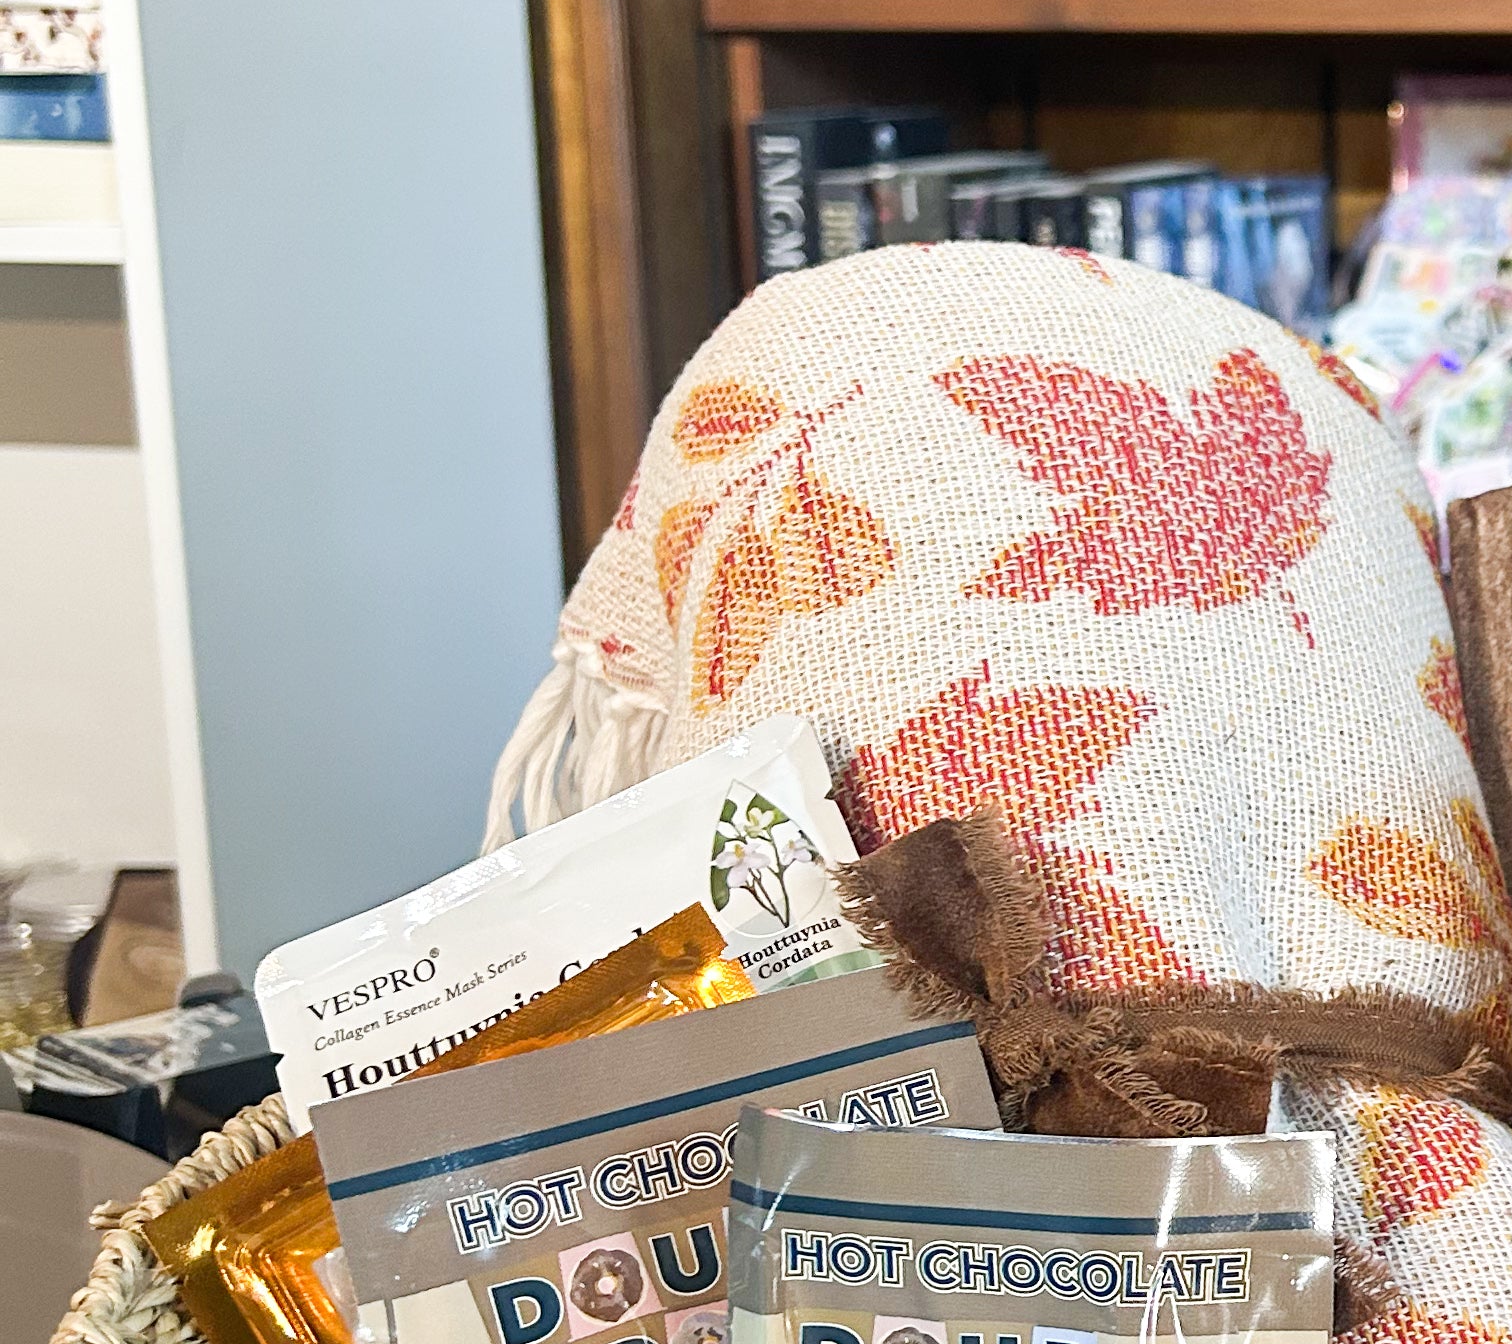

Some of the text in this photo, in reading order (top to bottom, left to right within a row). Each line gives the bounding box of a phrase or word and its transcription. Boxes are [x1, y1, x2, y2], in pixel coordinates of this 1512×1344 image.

[738, 915, 843, 971] Houttuynia
[757, 936, 834, 981] Cordata
[314, 1021, 381, 1052] Collagen
[384, 995, 443, 1025] Essence
[445, 972, 485, 1003] Mask
[487, 948, 529, 980] Series
[448, 1168, 586, 1254] HOT
[781, 1228, 1251, 1306] HOT CHOCOLATE
